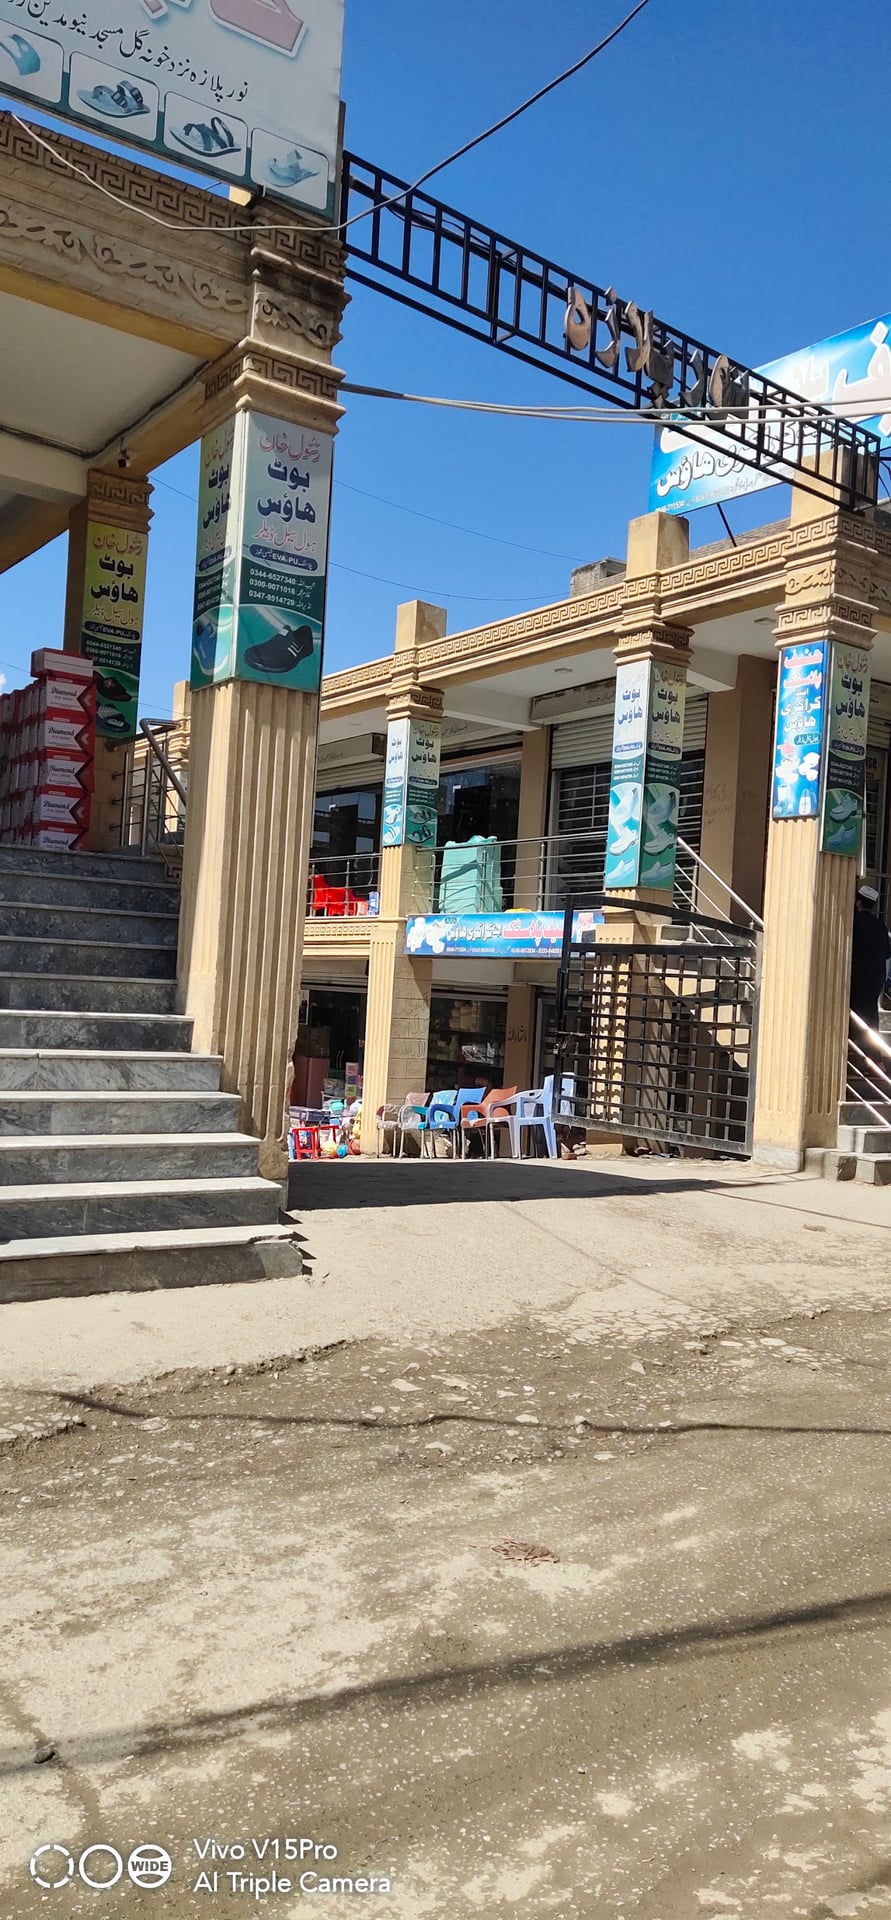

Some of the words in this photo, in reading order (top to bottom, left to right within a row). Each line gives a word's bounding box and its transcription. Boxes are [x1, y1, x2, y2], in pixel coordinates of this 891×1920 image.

[88, 27, 124, 49] مسجد
[119, 29, 150, 58] گل
[189, 70, 223, 103] پلازہ
[227, 81, 248, 102] نور
[259, 431, 289, 453] خان
[267, 458, 310, 493] بوٹ
[99, 553, 134, 580] بوٹ
